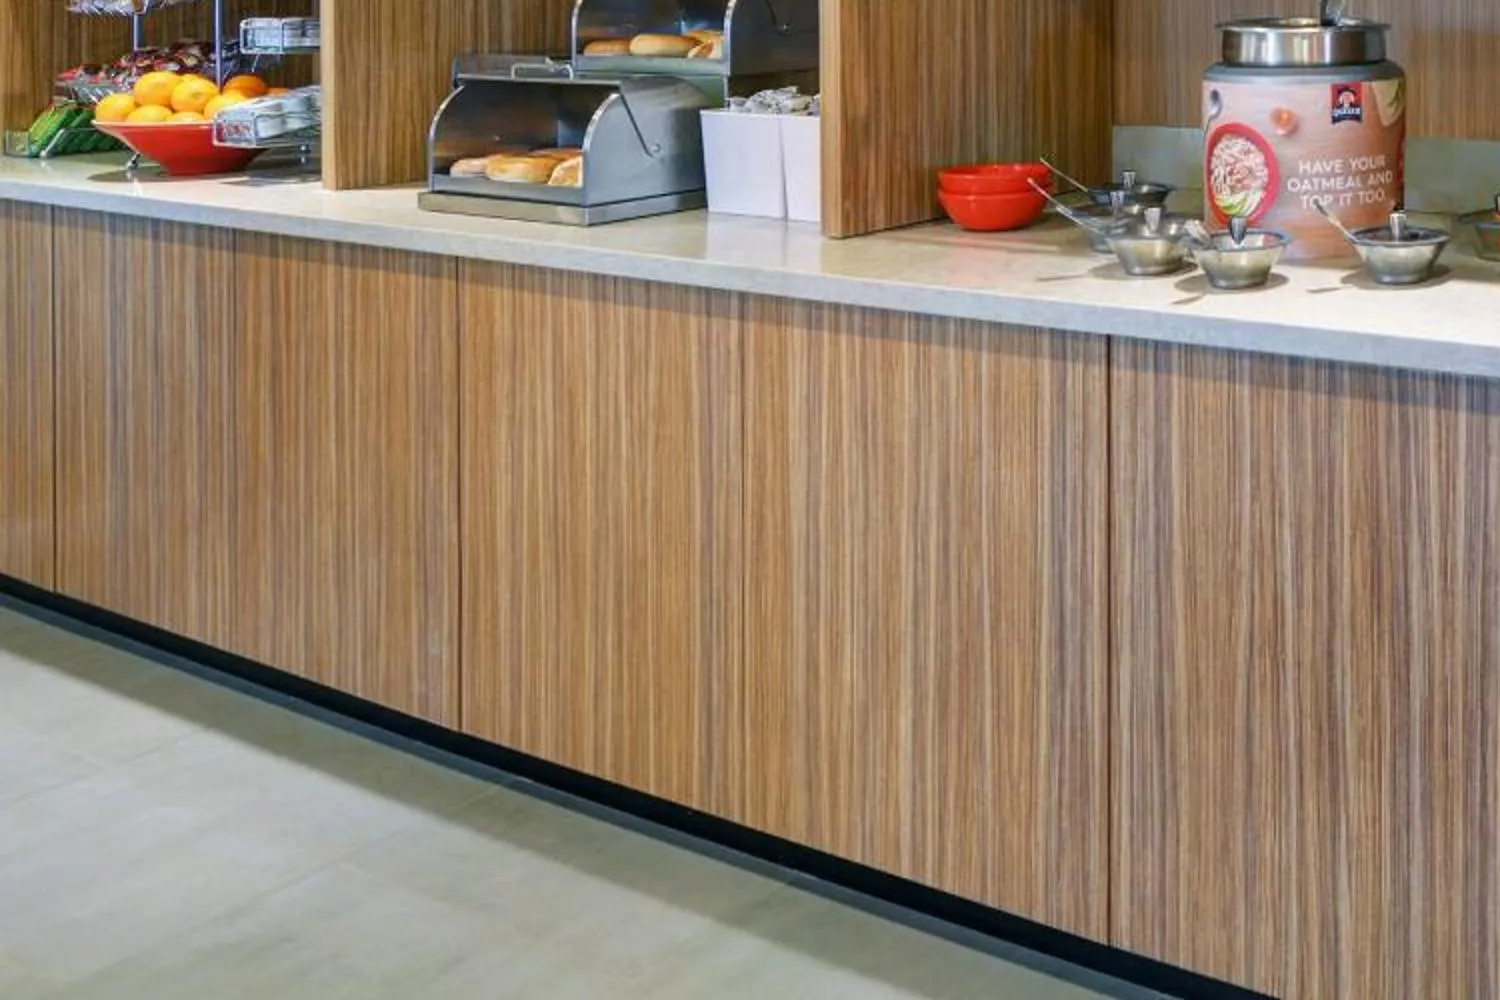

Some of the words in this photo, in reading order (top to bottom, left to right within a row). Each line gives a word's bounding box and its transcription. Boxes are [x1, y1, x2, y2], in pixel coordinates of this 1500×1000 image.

[1298, 159, 1344, 174] HAVE
[1349, 155, 1386, 171] YOUR
[1287, 175, 1363, 192] OATMEAL
[1368, 170, 1393, 186] AND
[1300, 194, 1333, 209] TOP
[1338, 193, 1353, 207] IT
